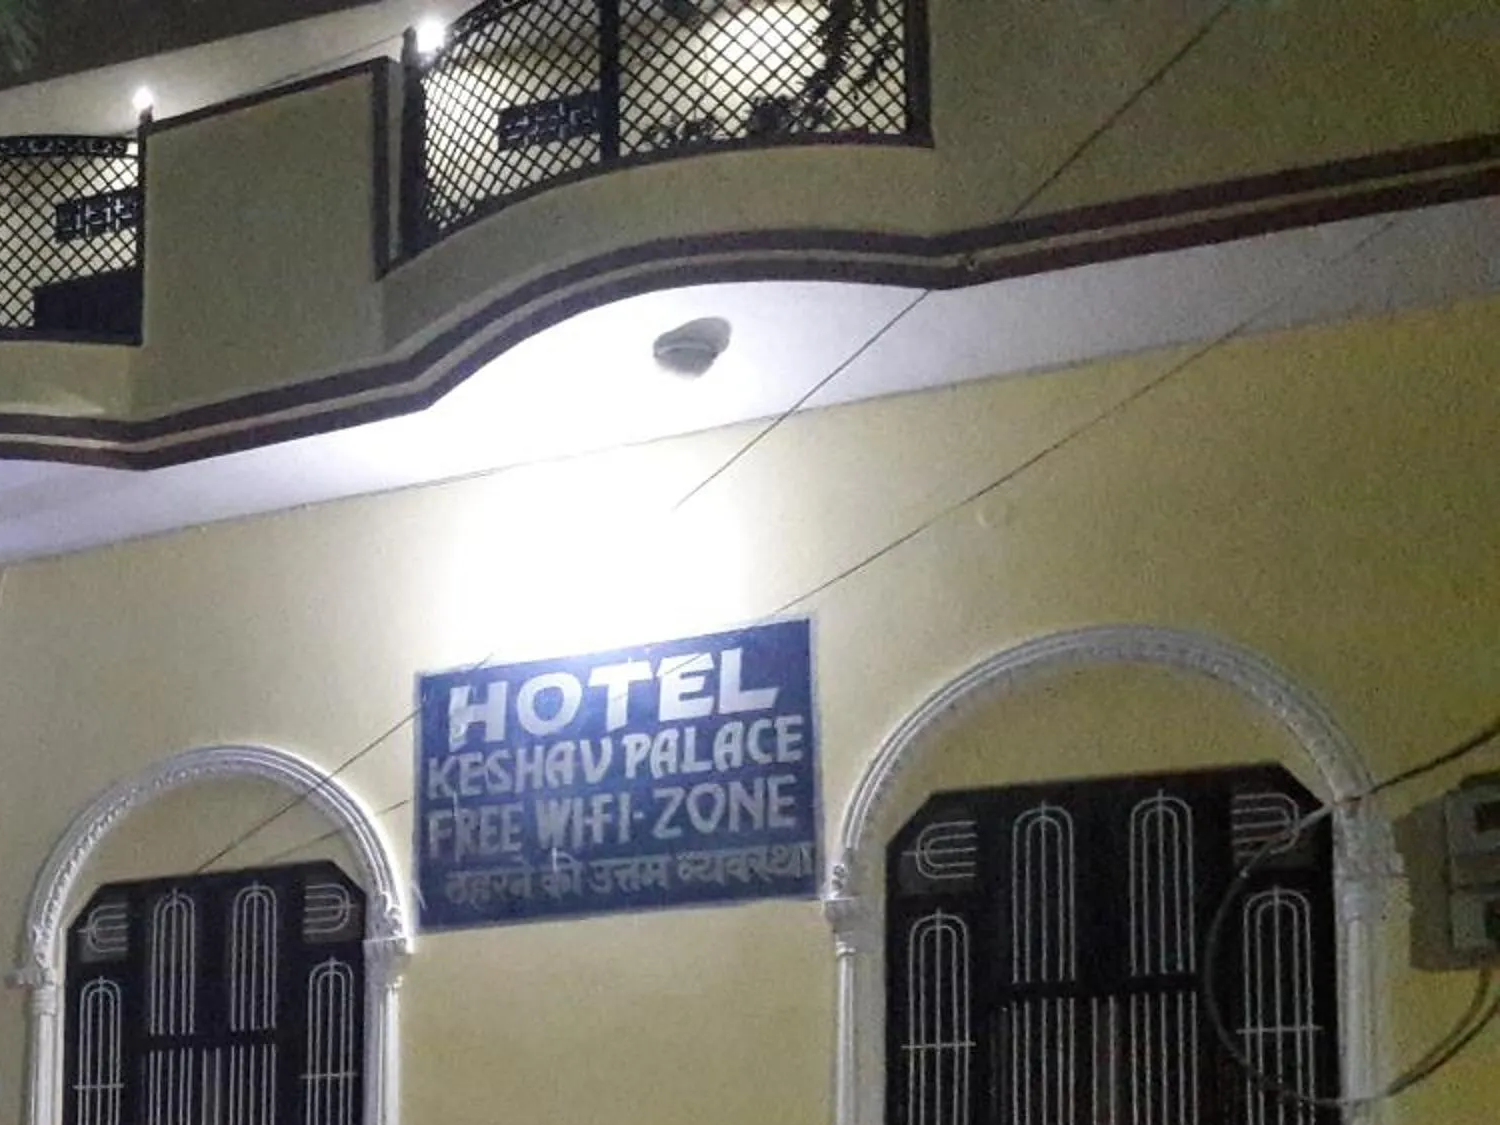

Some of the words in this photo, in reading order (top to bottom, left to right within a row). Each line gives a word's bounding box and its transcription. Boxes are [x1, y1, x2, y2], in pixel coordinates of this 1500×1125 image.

[448, 647, 778, 752] HOTEL
[428, 736, 613, 800] KESHAV
[621, 715, 805, 779] PALACE
[428, 801, 524, 861] FREE
